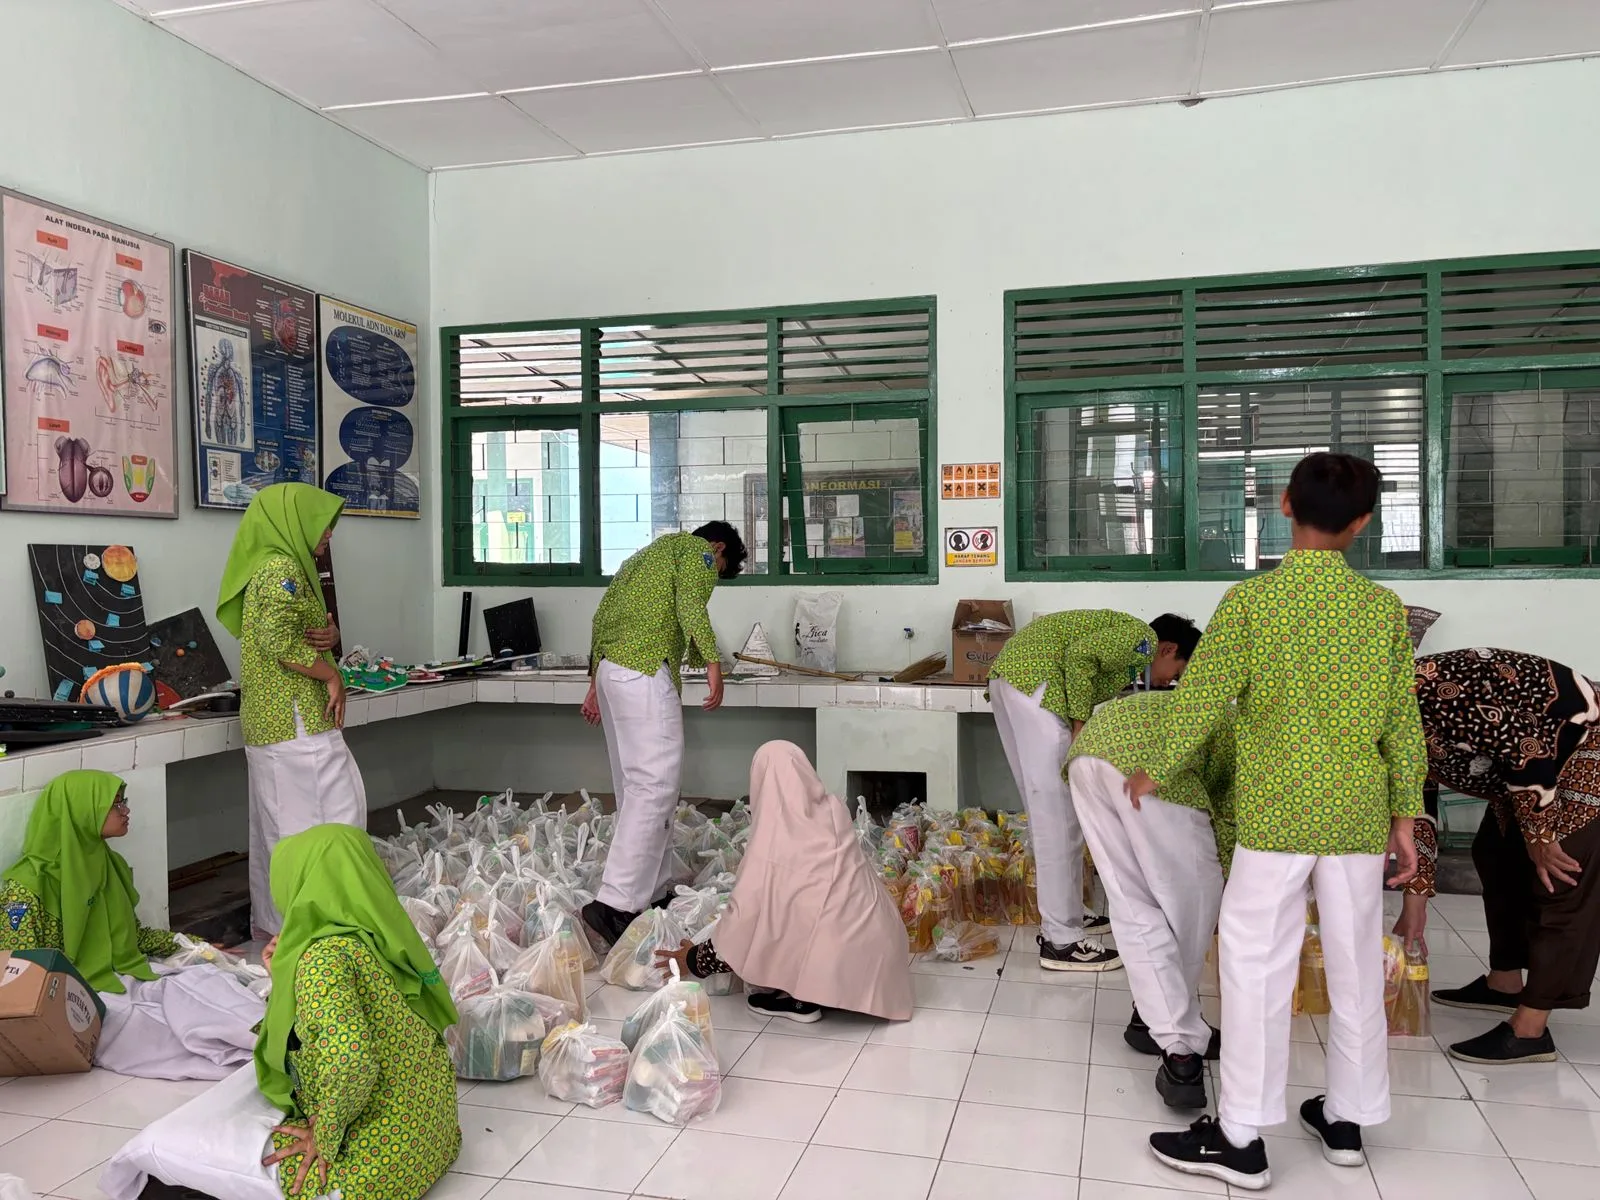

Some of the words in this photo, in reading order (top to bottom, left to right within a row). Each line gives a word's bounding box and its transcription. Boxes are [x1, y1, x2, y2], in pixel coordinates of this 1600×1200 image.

[45, 215, 63, 226] ALAT
[66, 221, 91, 234] INDERA
[92, 229, 110, 241] PADA
[333, 309, 365, 328] MOLEKUL
[380, 324, 393, 336] DAN
[805, 479, 881, 492] INFORMASI
